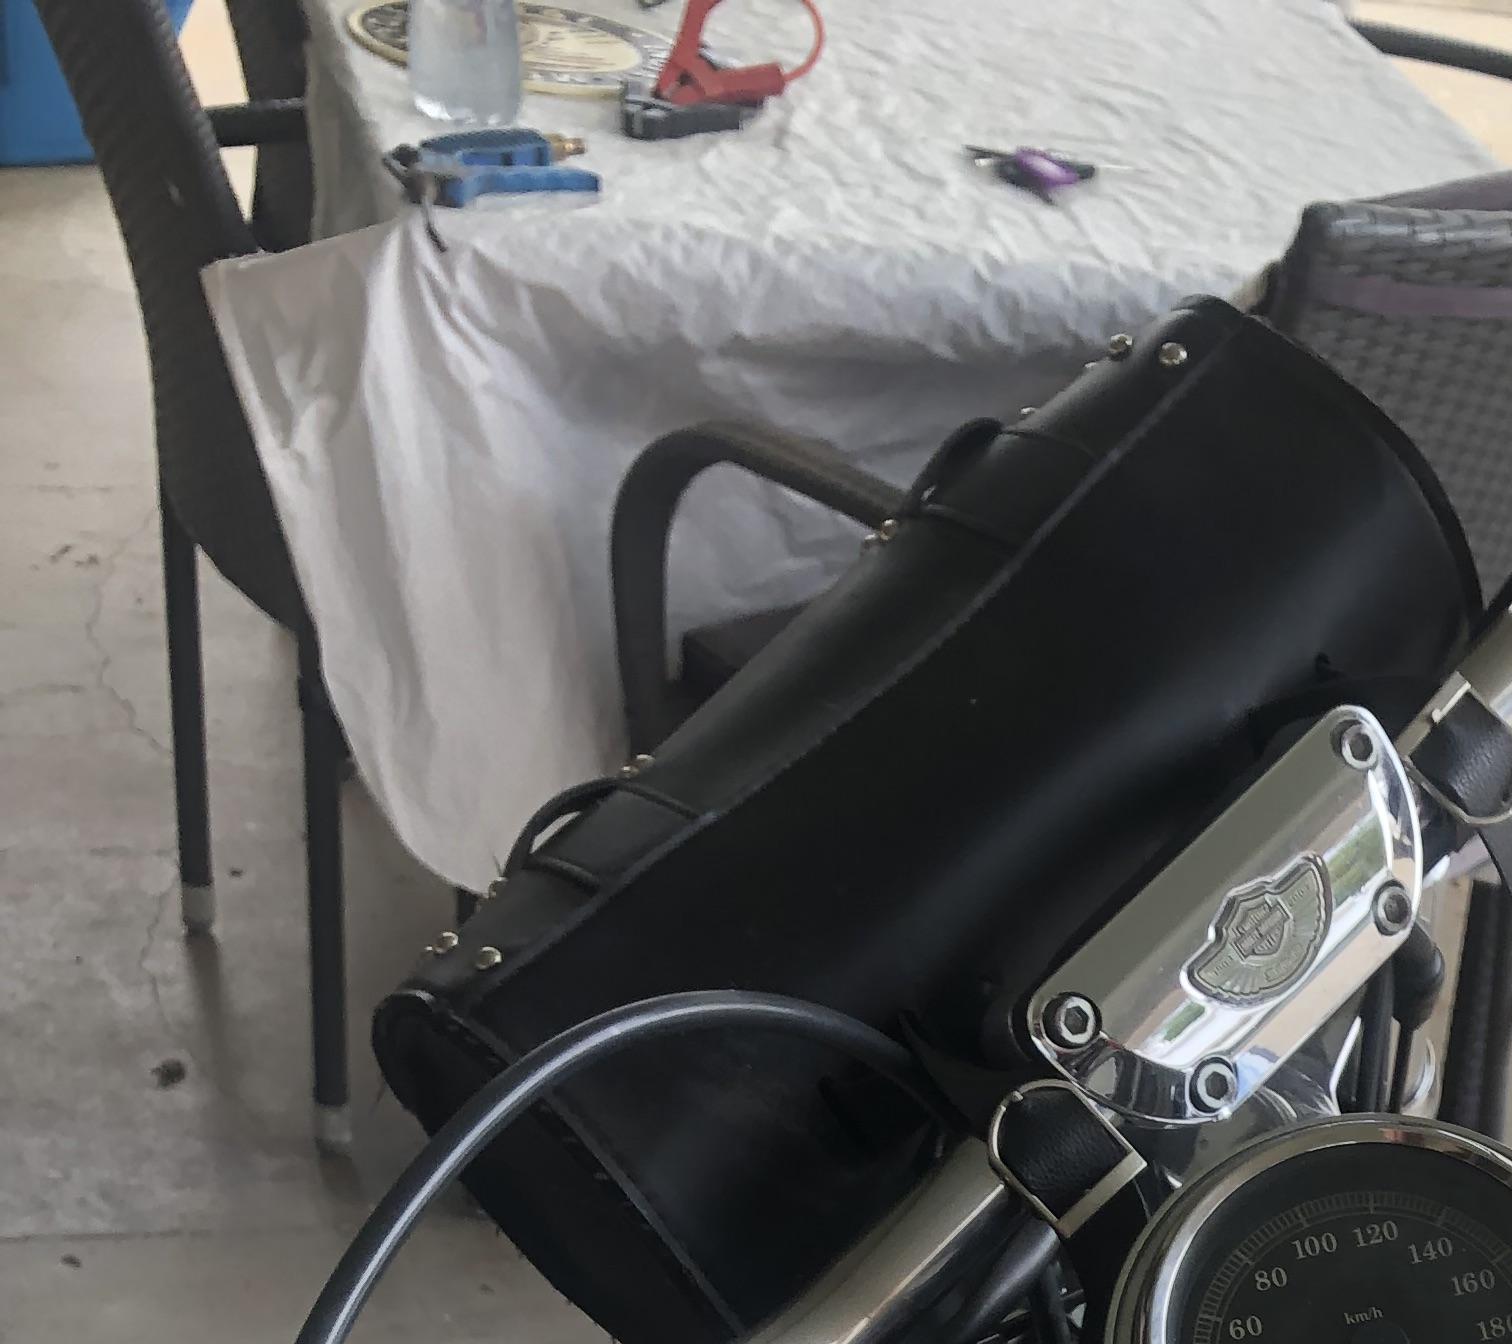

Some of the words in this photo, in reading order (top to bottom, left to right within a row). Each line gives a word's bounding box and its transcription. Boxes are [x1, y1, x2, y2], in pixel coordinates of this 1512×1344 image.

[1292, 1232, 1339, 1259] 100
[1352, 1220, 1400, 1249] 120
[1407, 1237, 1454, 1264] 140
[1254, 1267, 1288, 1291] 80
[1450, 1269, 1496, 1296] 160
[1228, 1315, 1263, 1339] 60
[1343, 1307, 1384, 1326] km/h
